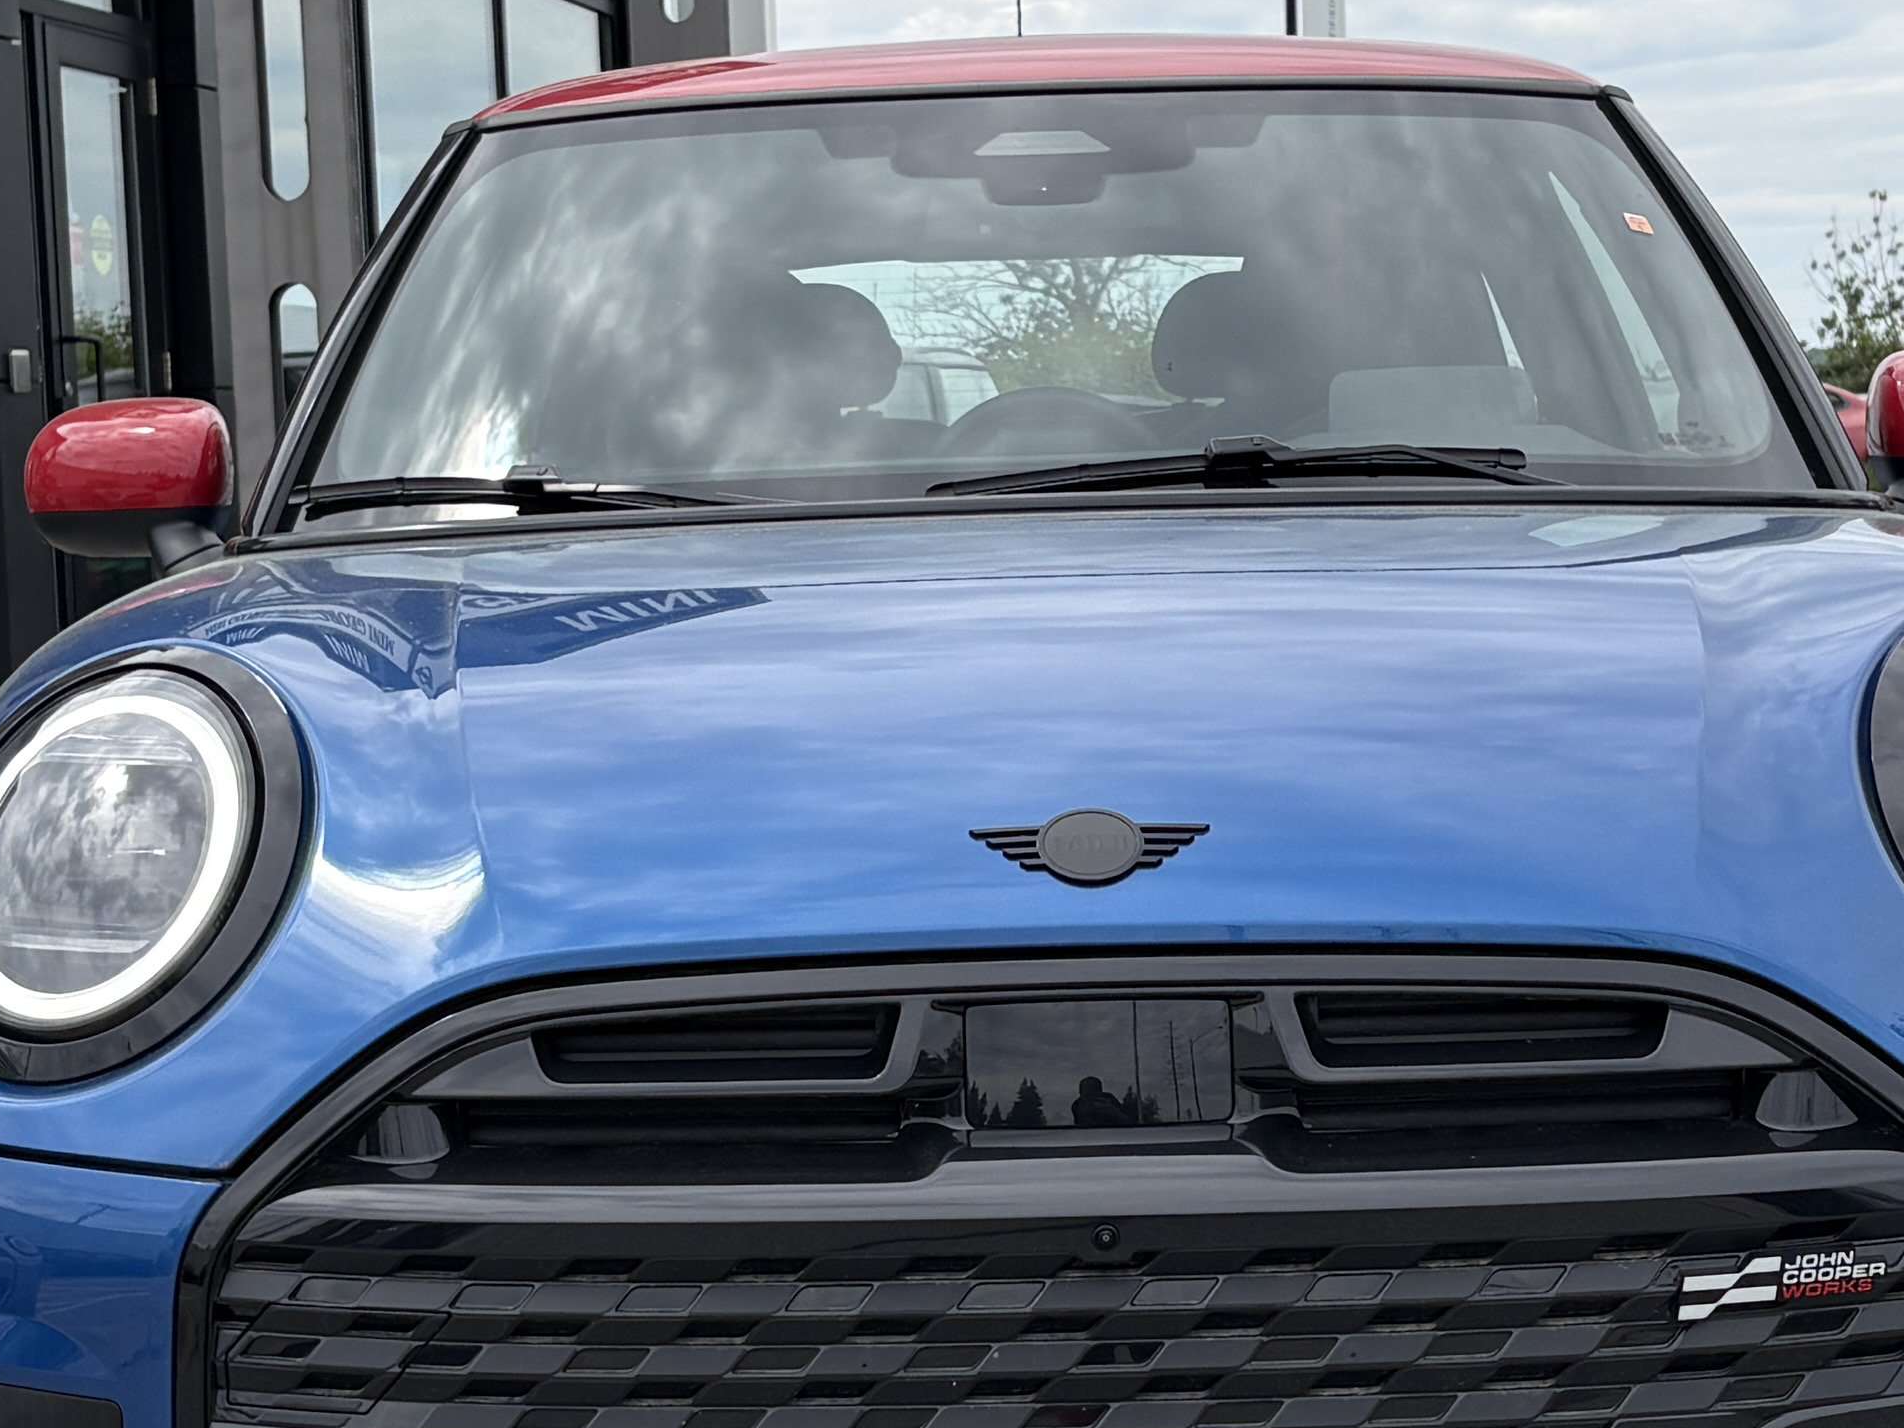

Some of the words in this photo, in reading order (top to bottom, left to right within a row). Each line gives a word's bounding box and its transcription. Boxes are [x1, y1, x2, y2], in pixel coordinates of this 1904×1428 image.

[1785, 1250, 1853, 1269] JOHN
[1783, 1263, 1885, 1284] COOPER
[1783, 1278, 1872, 1298] WORKS
